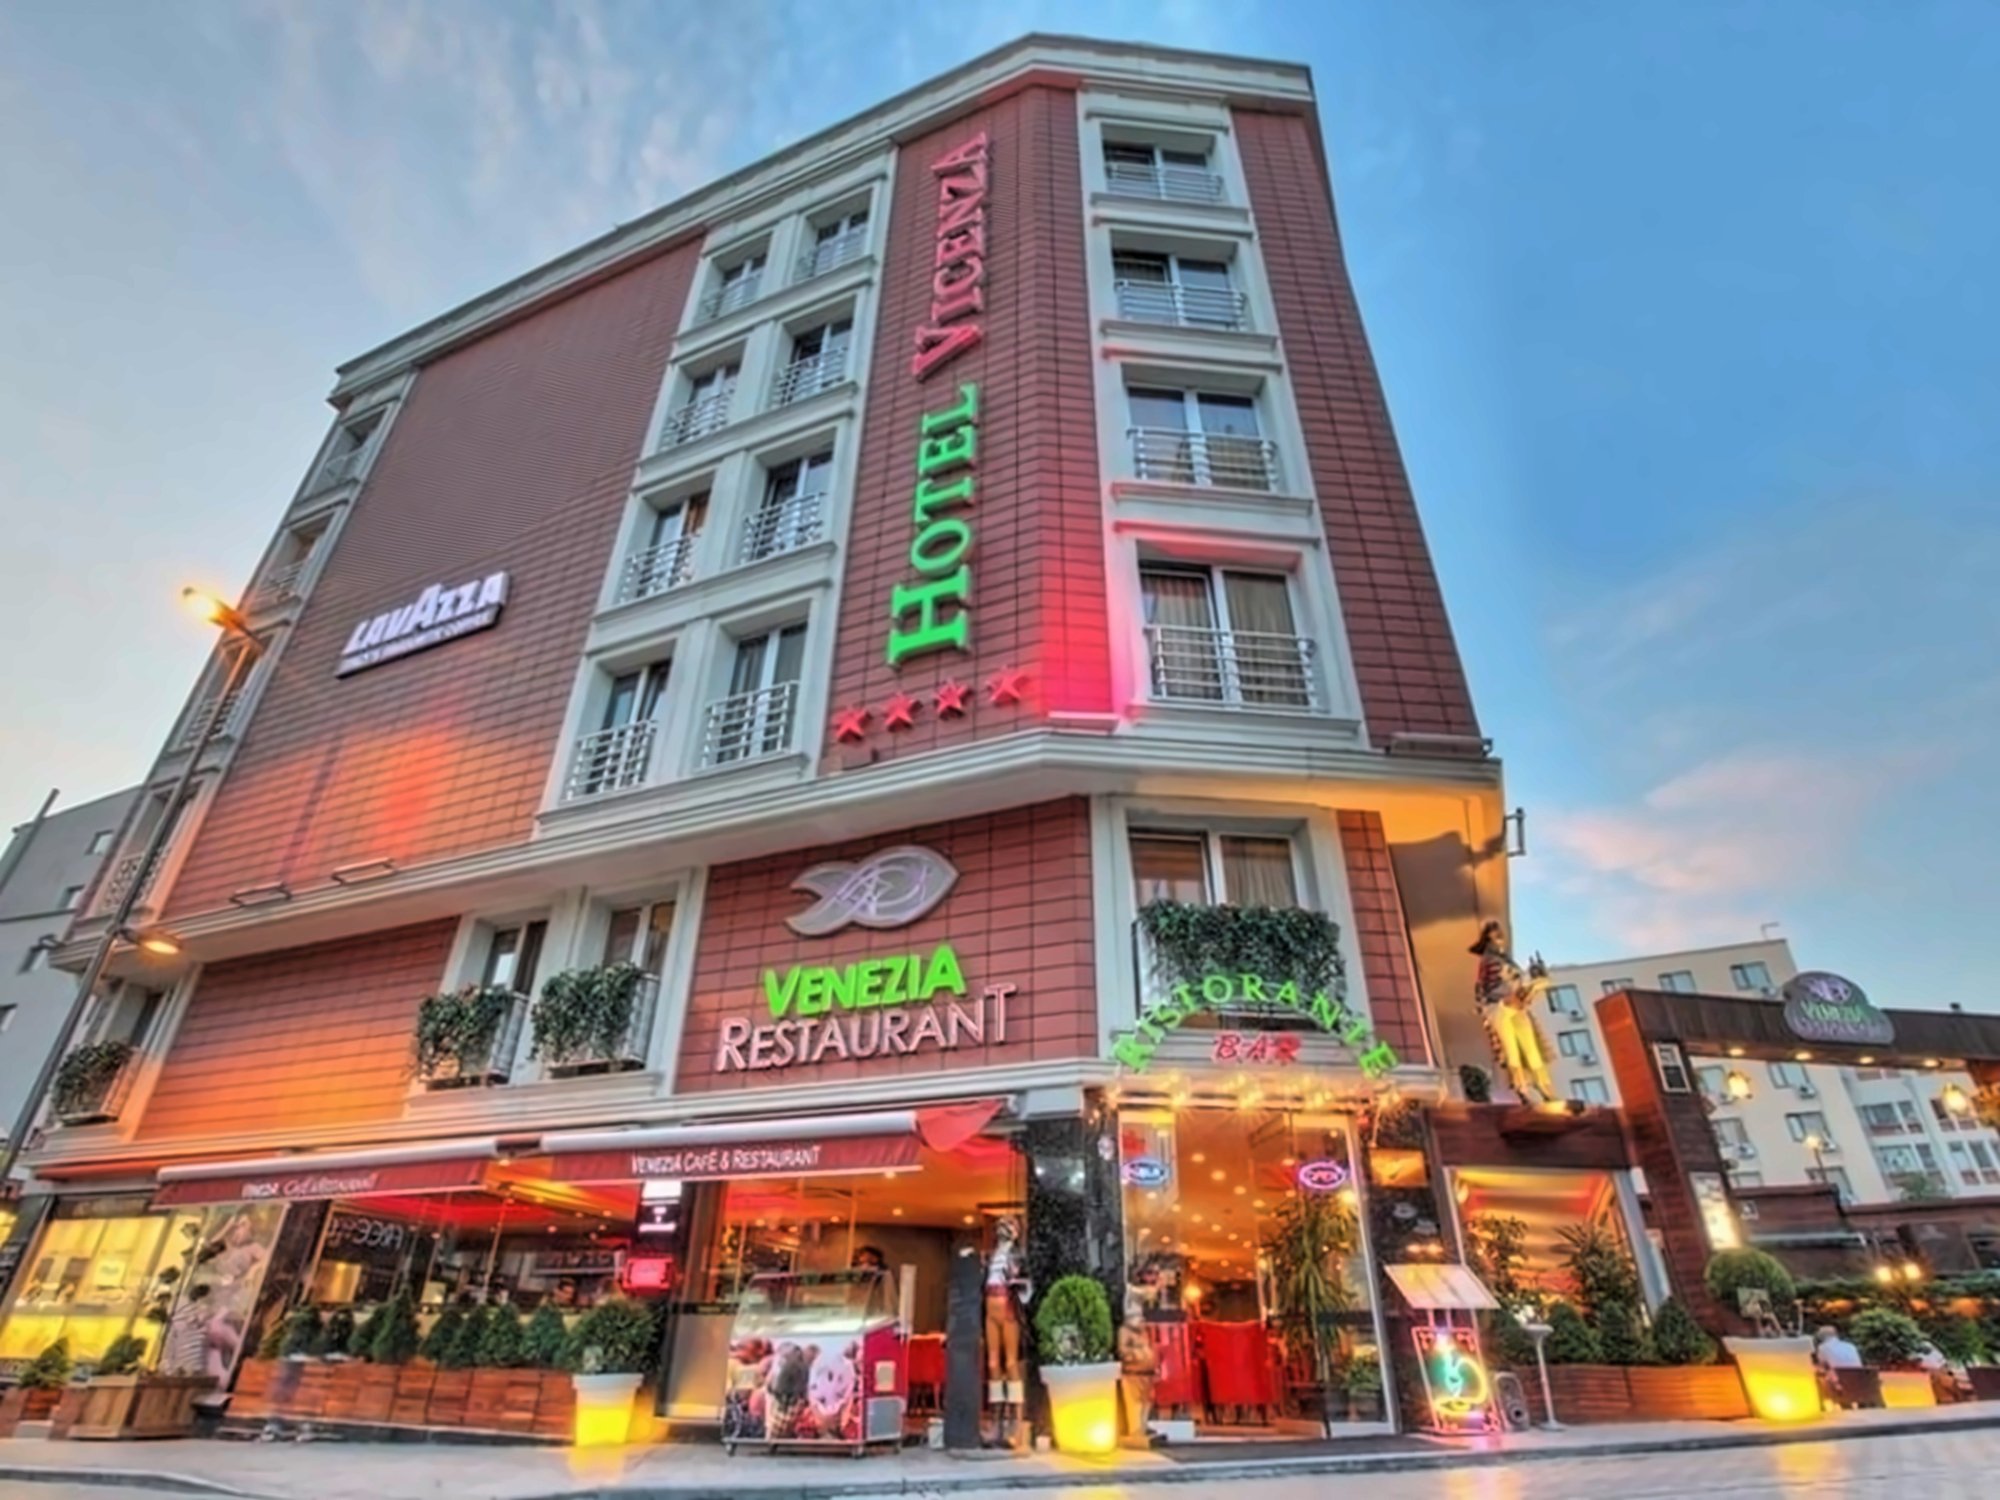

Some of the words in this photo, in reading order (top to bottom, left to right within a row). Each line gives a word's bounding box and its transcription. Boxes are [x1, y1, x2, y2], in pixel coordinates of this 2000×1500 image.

[913, 132, 989, 381] VICENZA
[886, 383, 980, 668] HOTEL
[341, 571, 510, 656] LAVAZZA
[765, 943, 966, 1018] VENEZIA
[717, 983, 1017, 1072] RESTAURANT
[1211, 1030, 1304, 1064] BAR
[731, 1145, 821, 1169] RESTAURANT
